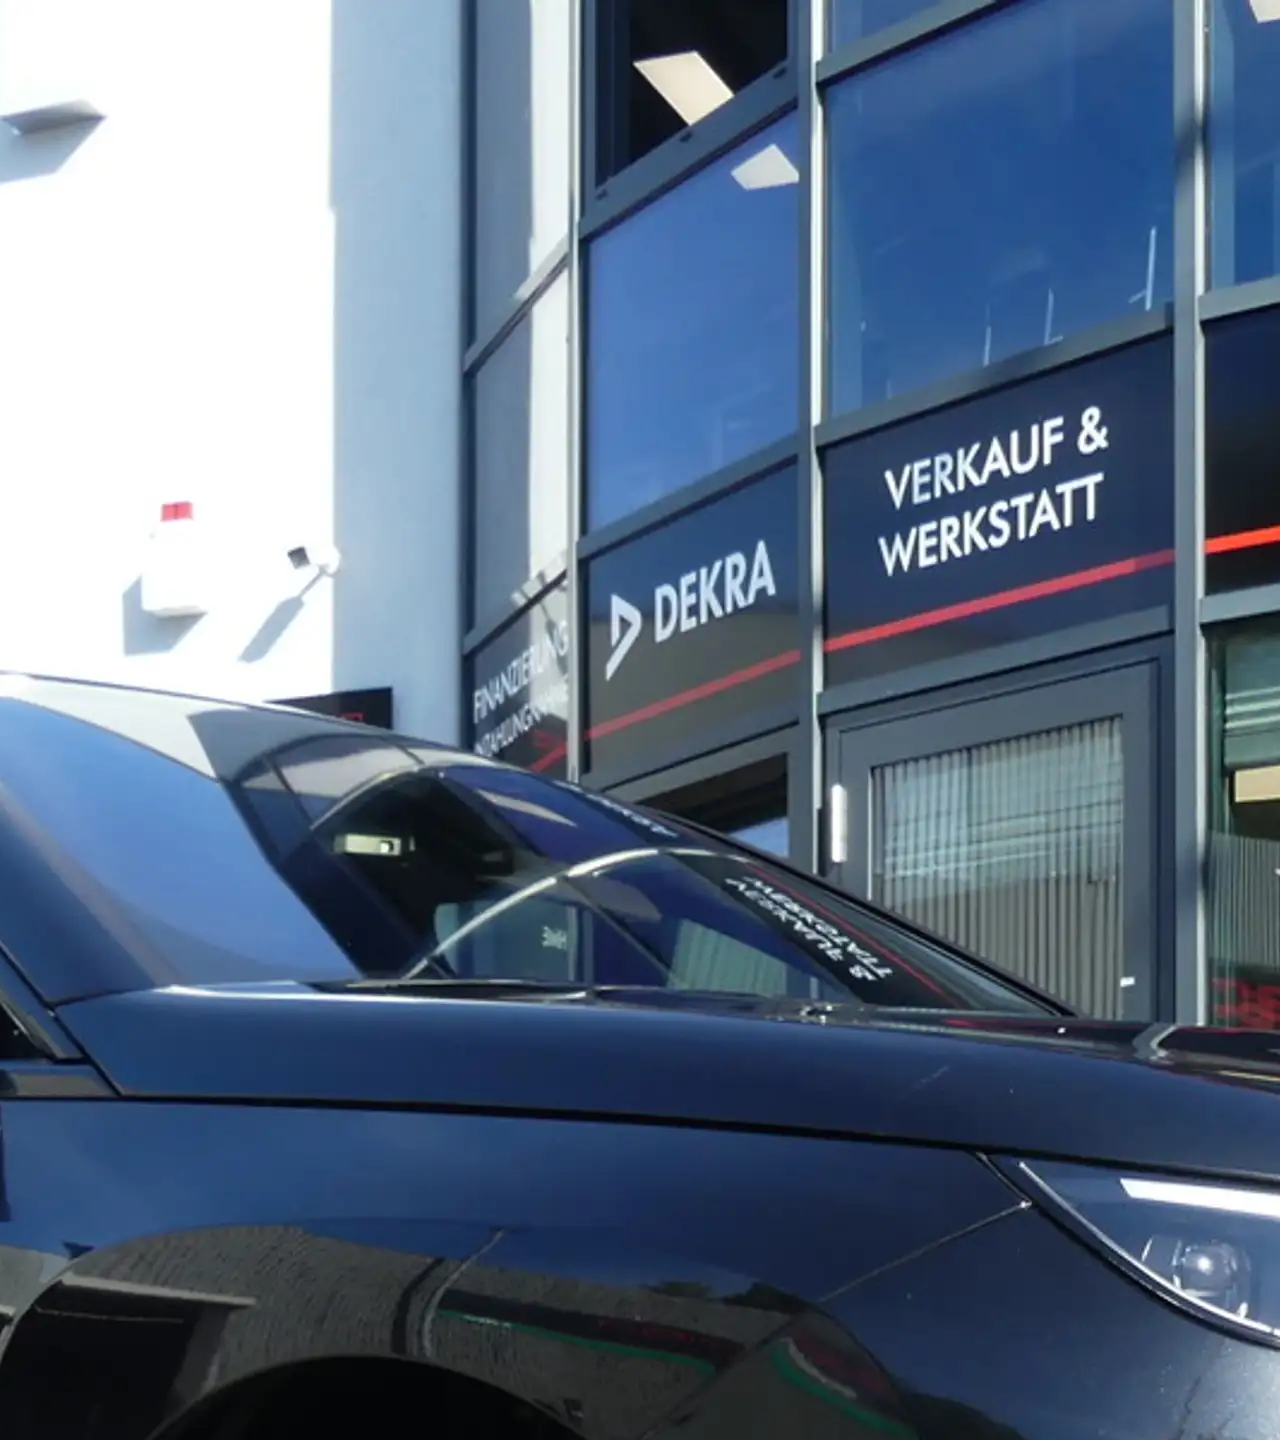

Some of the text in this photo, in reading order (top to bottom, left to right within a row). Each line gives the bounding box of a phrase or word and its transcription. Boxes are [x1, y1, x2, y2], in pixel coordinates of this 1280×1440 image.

[883, 405, 1110, 511] VERKAUF &
[877, 471, 1105, 578] WERKSTATT
[653, 540, 777, 643] DEKRA
